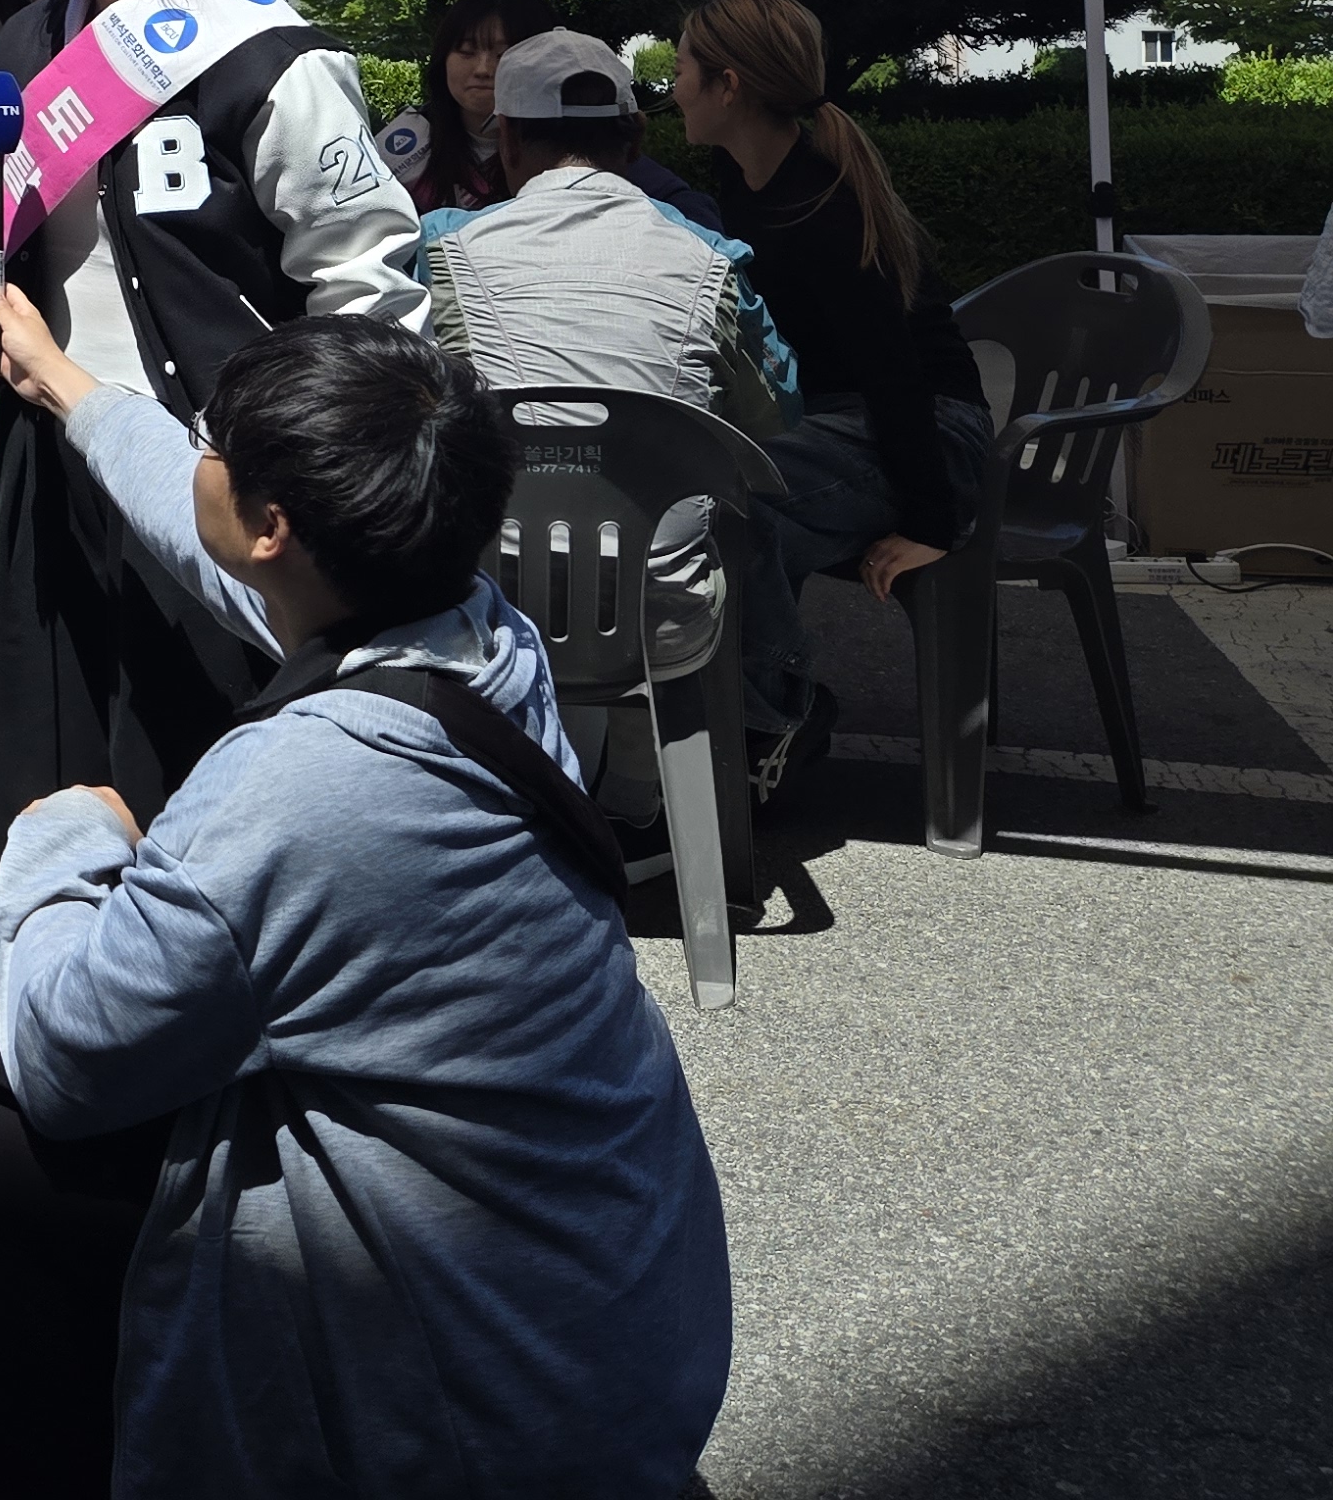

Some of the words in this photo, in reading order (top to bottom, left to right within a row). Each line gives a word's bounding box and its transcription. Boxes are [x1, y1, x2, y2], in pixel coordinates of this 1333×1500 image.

[109, 13, 172, 90] 백석문화대학교
[160, 23, 179, 40] BCU
[134, 115, 212, 215] B
[525, 463, 601, 474] 1577-7415
